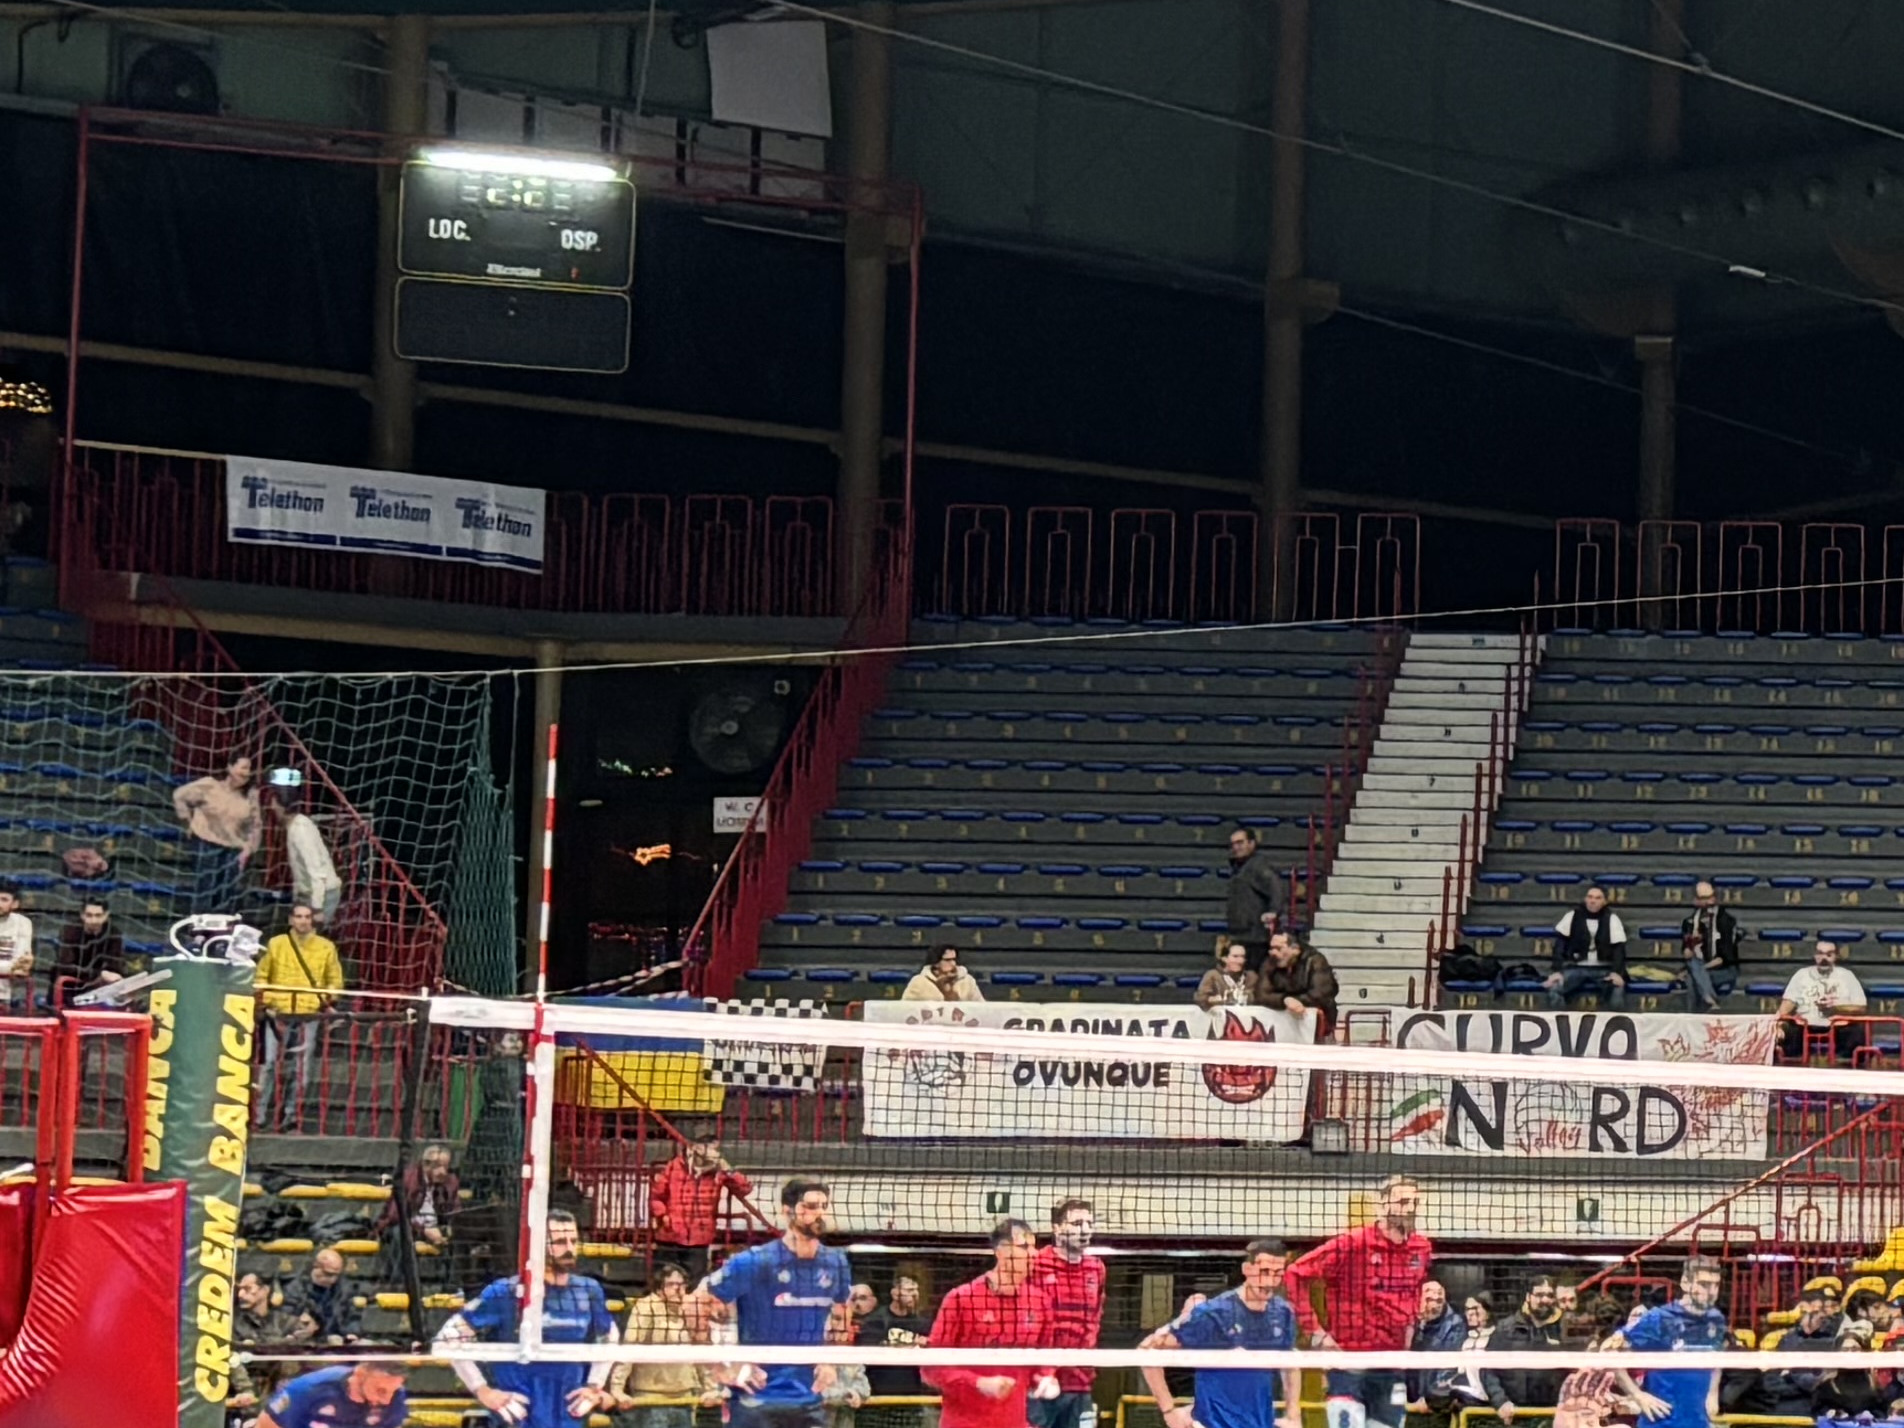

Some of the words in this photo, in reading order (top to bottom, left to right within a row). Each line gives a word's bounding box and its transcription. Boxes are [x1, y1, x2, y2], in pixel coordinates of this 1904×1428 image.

[350, 486, 431, 524] Telethon
[207, 993, 255, 1176] BANCA
[1012, 1061, 1171, 1088] OVUNQUE
[194, 1196, 241, 1403] CREDEM
